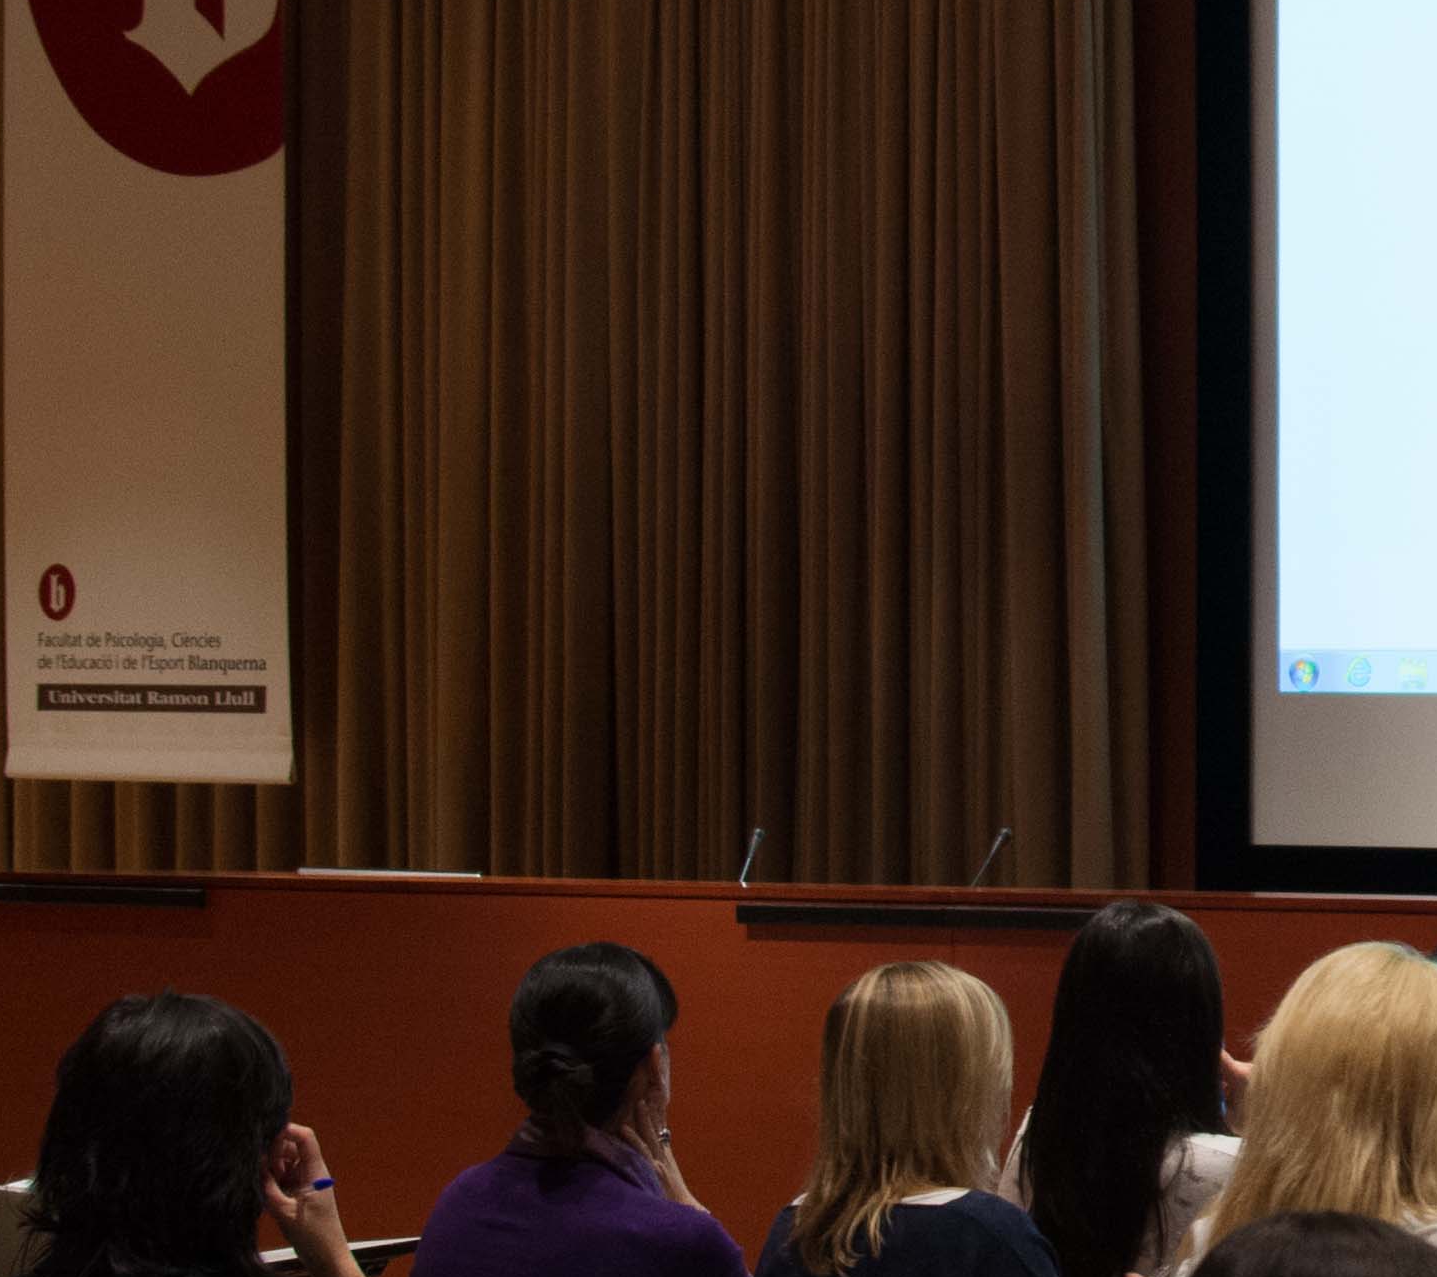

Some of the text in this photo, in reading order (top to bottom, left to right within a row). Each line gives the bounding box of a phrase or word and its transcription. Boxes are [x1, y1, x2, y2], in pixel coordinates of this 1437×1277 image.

[37, 632, 81, 648] Facultat
[86, 632, 101, 648] de
[37, 655, 52, 670] de
[122, 655, 138, 671] de
[188, 656, 267, 675] Blanquerna
[48, 689, 256, 707] Universitat Ramon Llull
